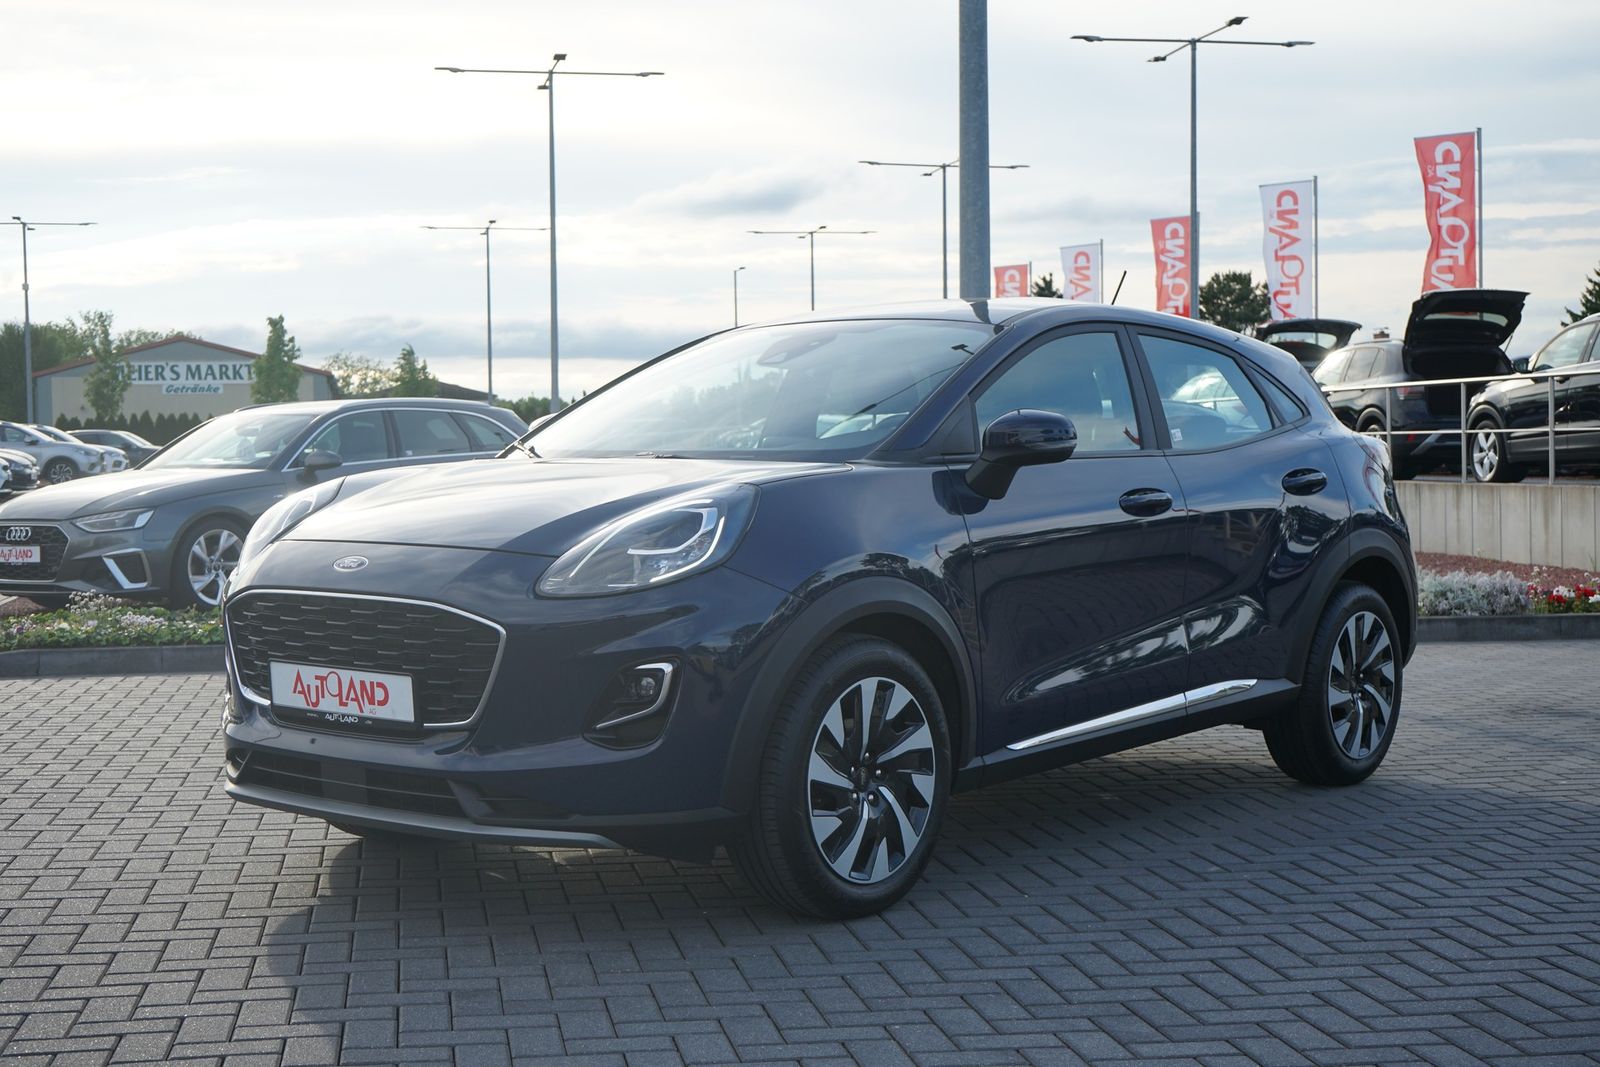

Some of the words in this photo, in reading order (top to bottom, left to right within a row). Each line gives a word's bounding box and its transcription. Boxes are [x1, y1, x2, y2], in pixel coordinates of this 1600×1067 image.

[185, 364, 255, 380] MARKT
[165, 384, 220, 394] Getränke
[293, 668, 389, 713] AUTOLAND
